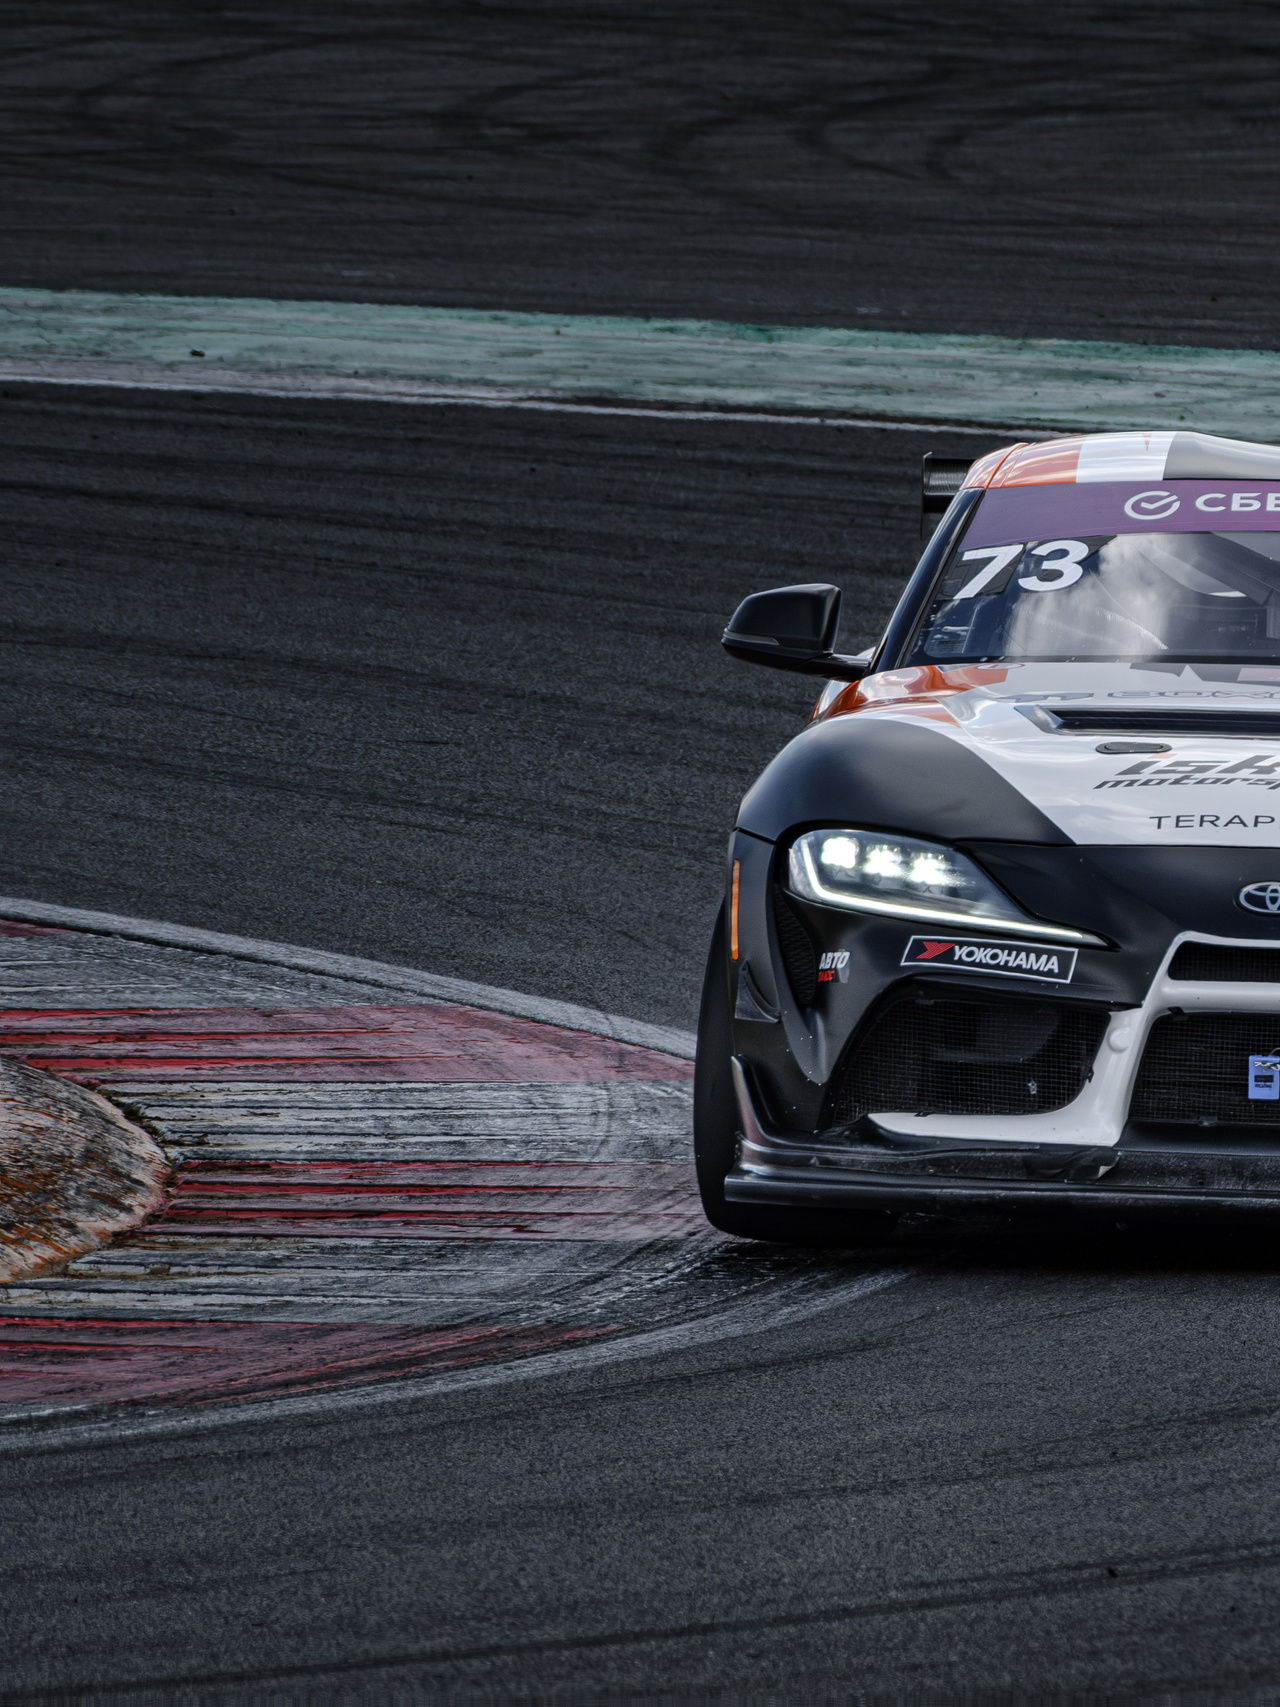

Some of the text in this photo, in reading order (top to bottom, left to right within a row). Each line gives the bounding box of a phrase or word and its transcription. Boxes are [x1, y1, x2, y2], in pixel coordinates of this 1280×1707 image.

[952, 539, 1090, 599] 73
[819, 951, 850, 970] АВТО
[953, 944, 1059, 973] YOKOHAMA
